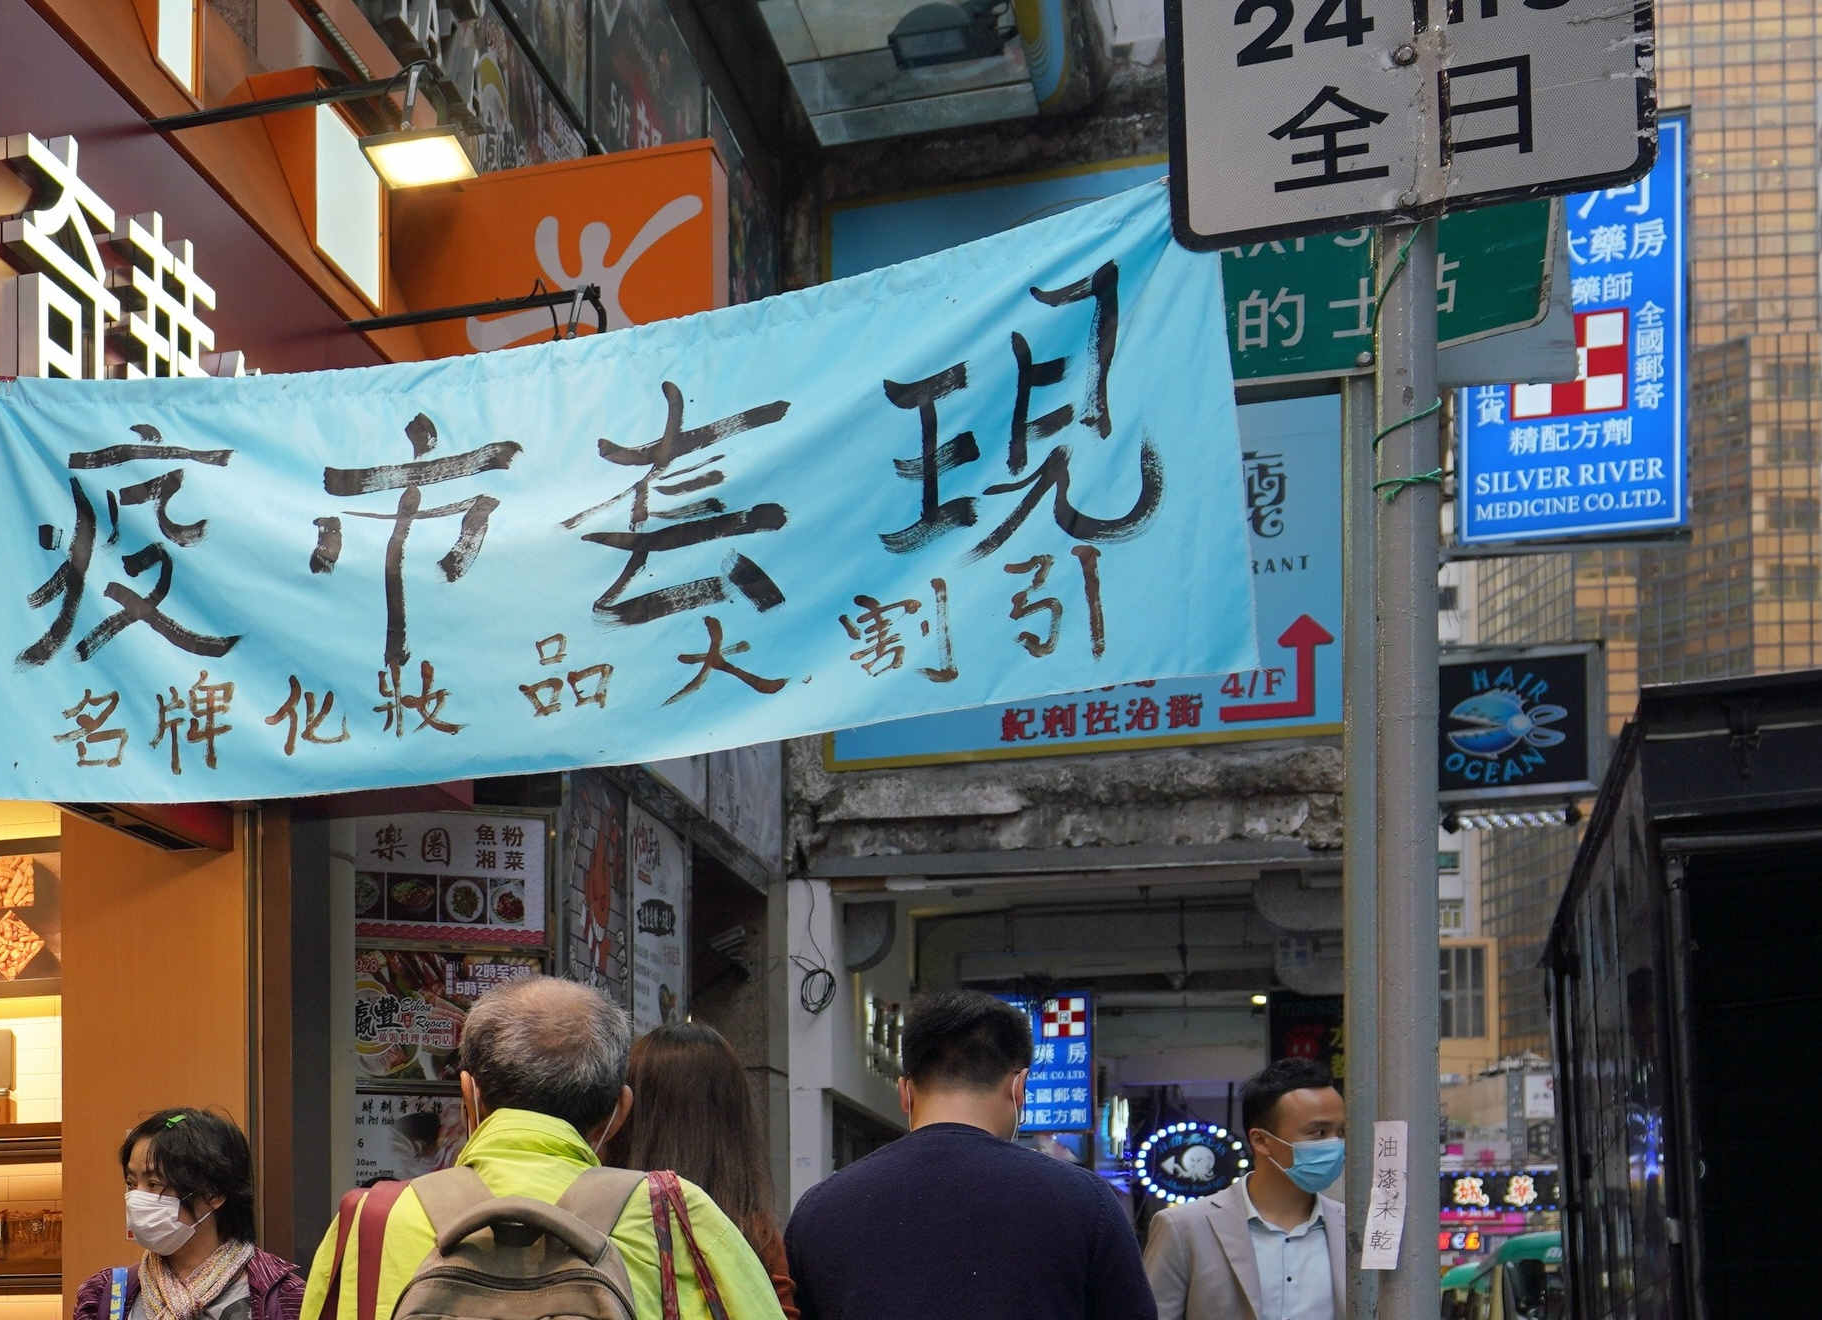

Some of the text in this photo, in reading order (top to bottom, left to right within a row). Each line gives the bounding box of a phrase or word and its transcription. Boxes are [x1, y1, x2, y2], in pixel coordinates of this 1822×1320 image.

[1268, 54, 1533, 193] 全日
[1634, 301, 1666, 410] 全國郵寄
[1509, 417, 1633, 456] 精配方劑
[16, 258, 1164, 667] 疫市套現
[1475, 457, 1665, 495] SILVER RIVER
[1475, 496, 1579, 522] MEDICINE
[1473, 666, 1549, 702] HAIR
[1445, 747, 1546, 784] OCEAN
[1369, 1136, 1399, 1251] 油漆未乾
